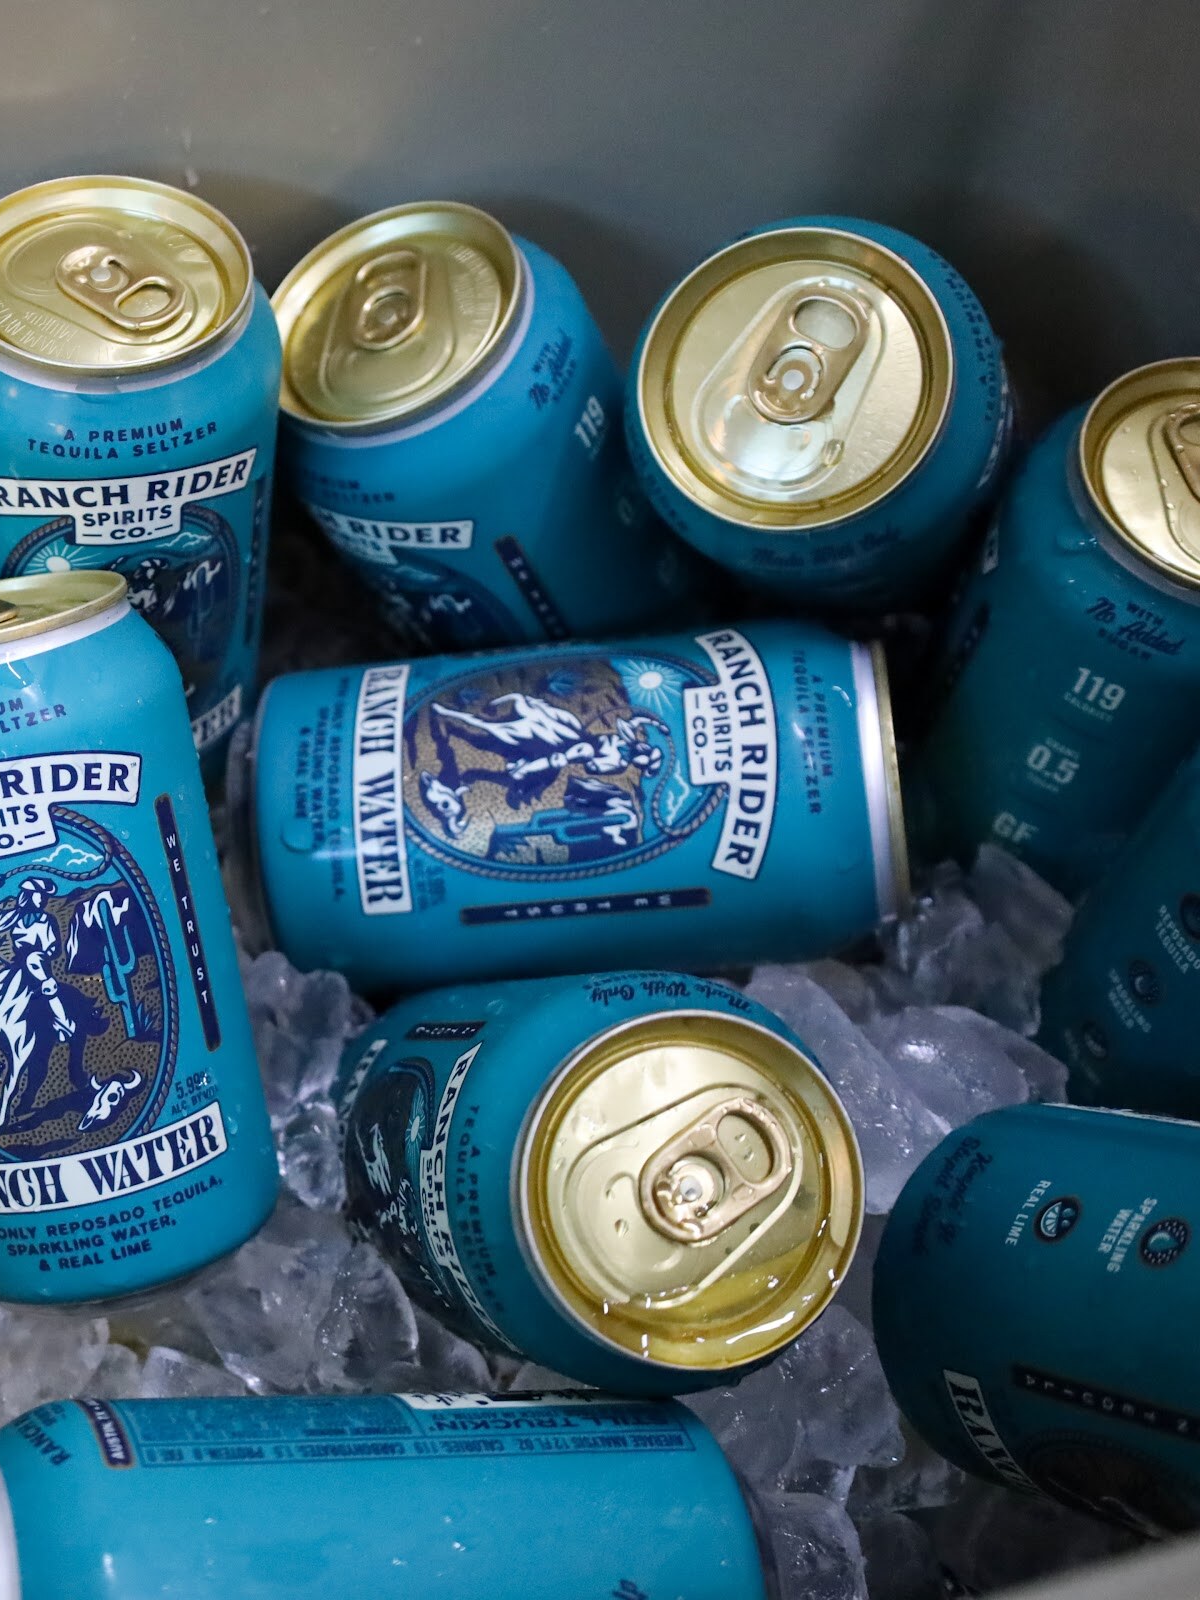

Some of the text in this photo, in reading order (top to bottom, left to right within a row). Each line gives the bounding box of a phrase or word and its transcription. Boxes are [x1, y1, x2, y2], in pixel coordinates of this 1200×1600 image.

[27, 420, 218, 460] TEQUILA SELTZER
[63, 417, 184, 443] A PREMIUM
[574, 395, 606, 449] 119
[145, 458, 247, 503] RIDER
[82, 503, 173, 528] SPIRITS
[109, 526, 153, 541] CO.
[348, 517, 464, 544] RIDER
[1085, 596, 1185, 657] No Added
[1126, 600, 1164, 626] WITH
[1071, 666, 1127, 711] 119
[691, 715, 710, 757] CO.
[705, 632, 769, 865] RANCH RIDER
[708, 690, 733, 773] SPIRITS
[813, 692, 833, 778] PREMIUM
[0, 762, 131, 798] RIDER
[358, 669, 405, 903] RANCH WATER
[1025, 744, 1079, 786] 0.5
[991, 810, 1041, 844] GF
[166, 834, 209, 1005] WE TRUST
[1158, 904, 1200, 970] REPOSADO
[589, 980, 753, 1012] Made With Only
[80, 1117, 221, 1197] WATER
[432, 1059, 472, 1210] RANCH
[454, 1104, 479, 1204] TEQUILA
[46, 1206, 144, 1237] REPOSADO
[153, 1177, 223, 1215] TEQUILA,
[424, 1159, 445, 1256] SPIRITS
[467, 1145, 497, 1278] A PREMIUM
[1005, 1179, 1052, 1248] REAL LIME
[7, 1218, 177, 1257] SPARKLING WATER,
[1098, 1208, 1135, 1254] WATER
[1105, 1197, 1158, 1273] SPARKLING
[39, 1239, 153, 1272] & REAL LIME
[429, 1417, 577, 1430] TRUCKIN'
